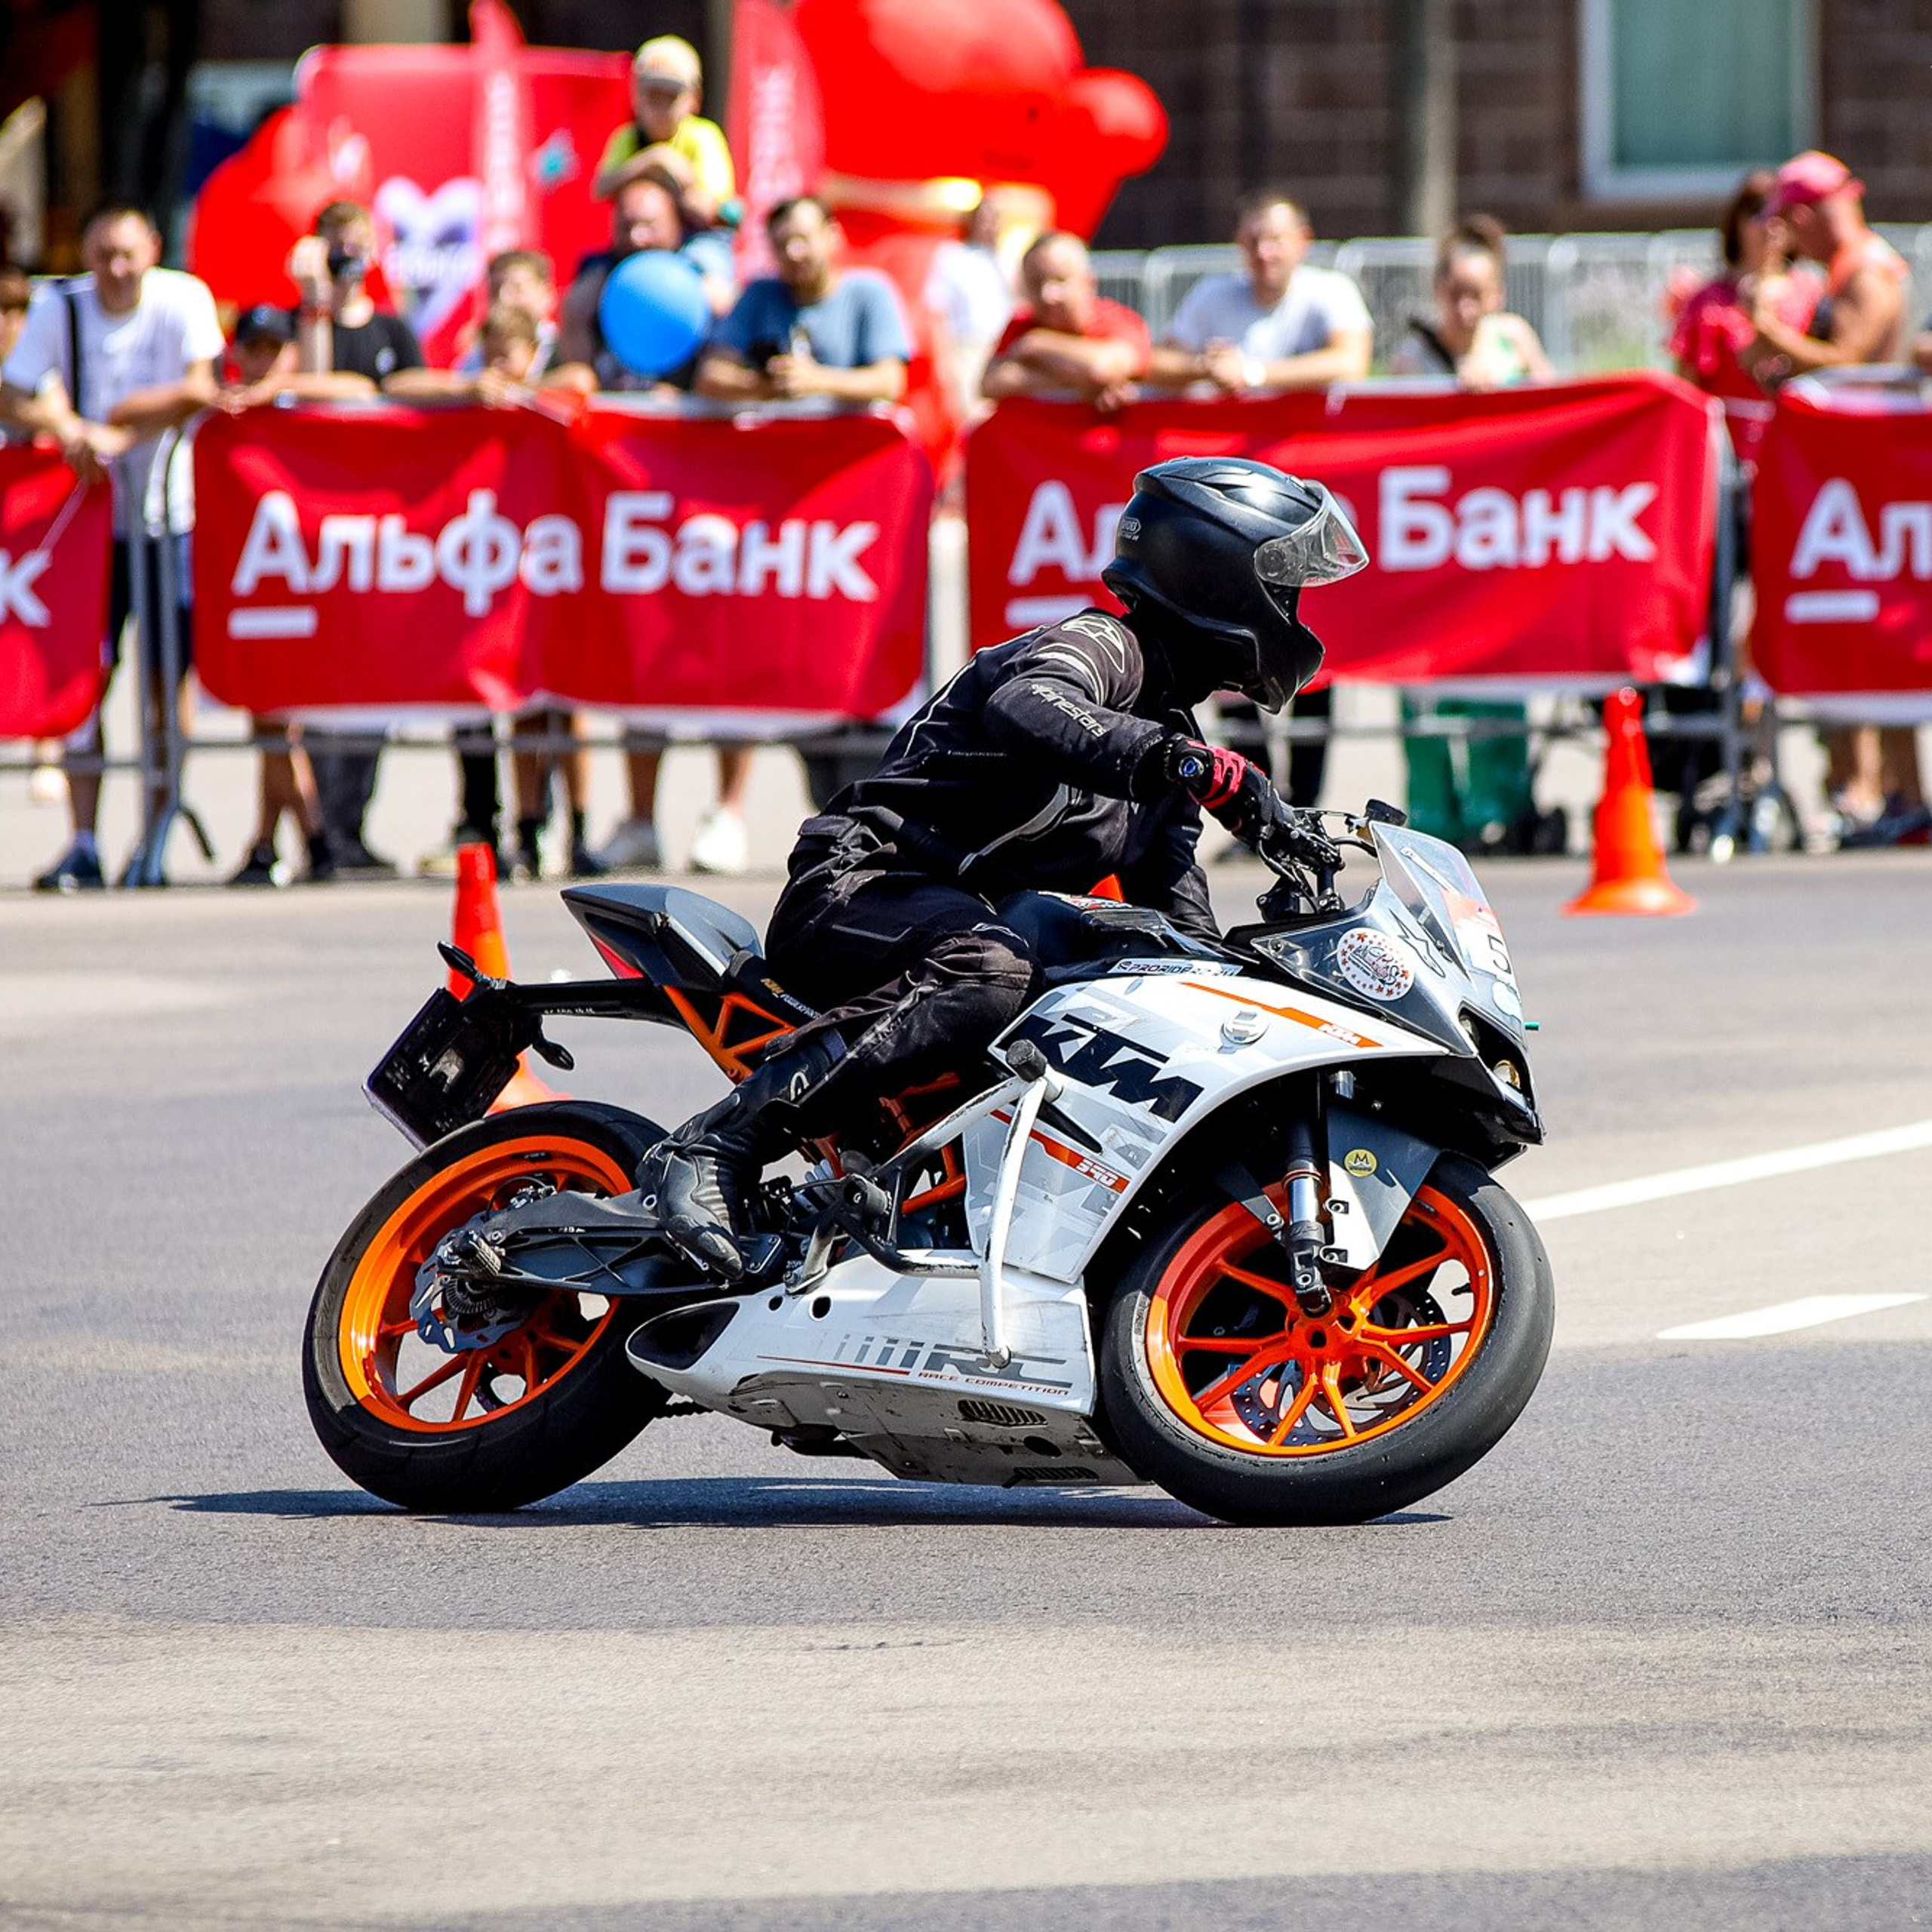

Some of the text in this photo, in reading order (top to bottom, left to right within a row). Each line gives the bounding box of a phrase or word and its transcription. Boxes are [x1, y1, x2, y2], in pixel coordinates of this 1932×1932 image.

[231, 488, 878, 617] Альфа Банк
[1377, 465, 1657, 571] Банк
[995, 1014, 1204, 1123] KTM
[918, 1372, 1069, 1395] RACE COMPETITION
